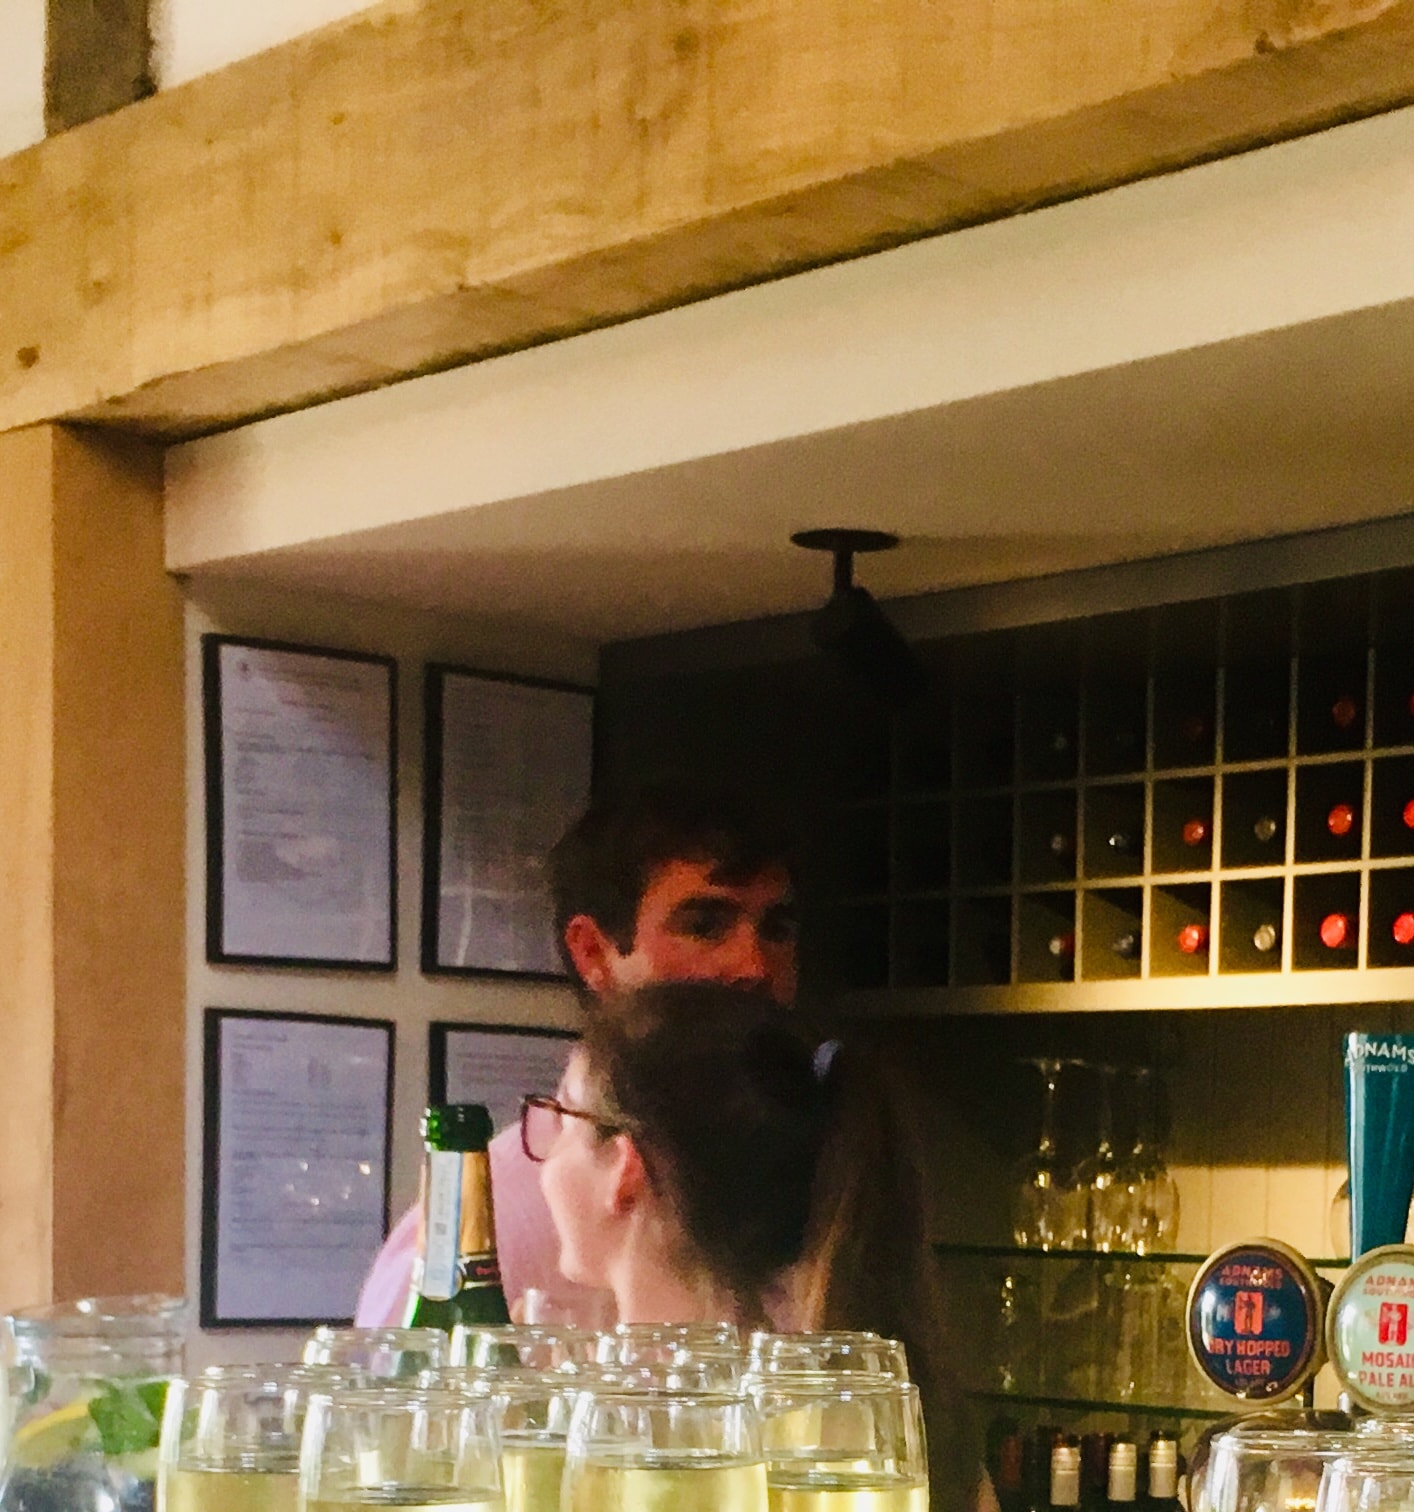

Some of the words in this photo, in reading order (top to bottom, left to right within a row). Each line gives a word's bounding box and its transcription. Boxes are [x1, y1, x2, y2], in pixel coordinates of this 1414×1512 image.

[1236, 1340, 1291, 1359] HOPPED
[1224, 1358, 1272, 1376] LAGER
[1357, 1370, 1395, 1389] PALE
